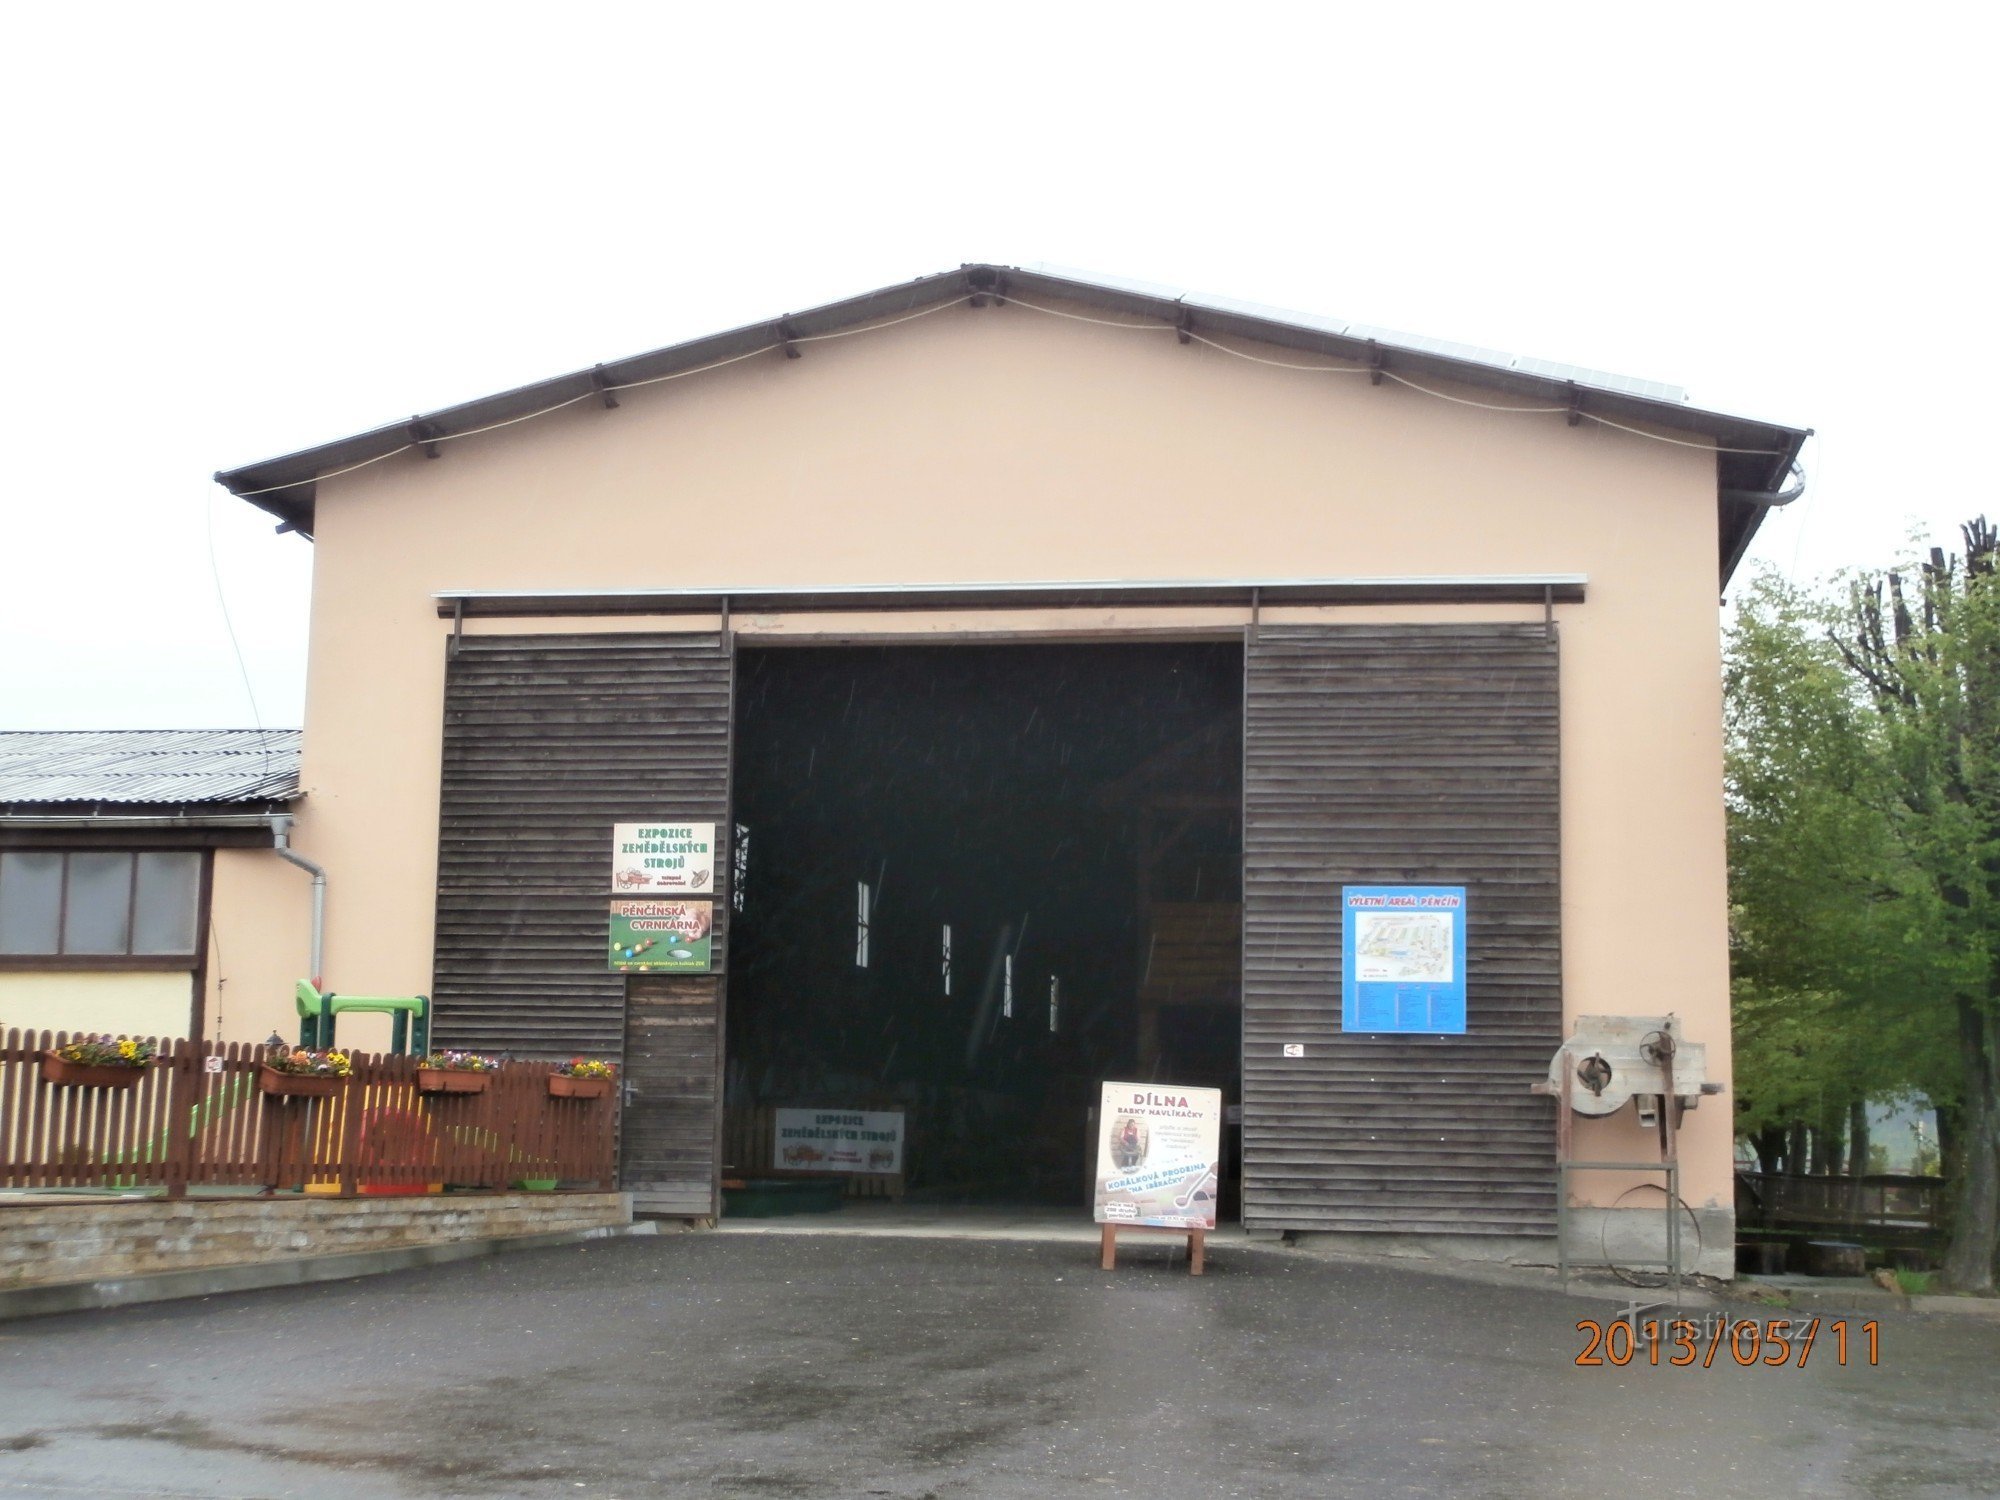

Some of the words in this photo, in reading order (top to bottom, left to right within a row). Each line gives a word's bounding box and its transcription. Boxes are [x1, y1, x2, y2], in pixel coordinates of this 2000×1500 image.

[638, 829, 693, 839] EXPOZICE
[622, 841, 708, 853] ZEMĚDĚLSKÝCH
[644, 855, 685, 870] STROJŮ
[622, 903, 686, 916] PĚNČÍNSKÁ
[631, 918, 700, 930] CVRNKÁRNA
[1133, 1092, 1189, 1108] DÍLNA
[1118, 1107, 1146, 1115] BABKY
[1149, 1109, 1204, 1119] NAVLÍKAČKY
[1107, 1171, 1160, 1190] KORÁLKOVÁ
[1162, 1162, 1206, 1178] PRODEJNA
